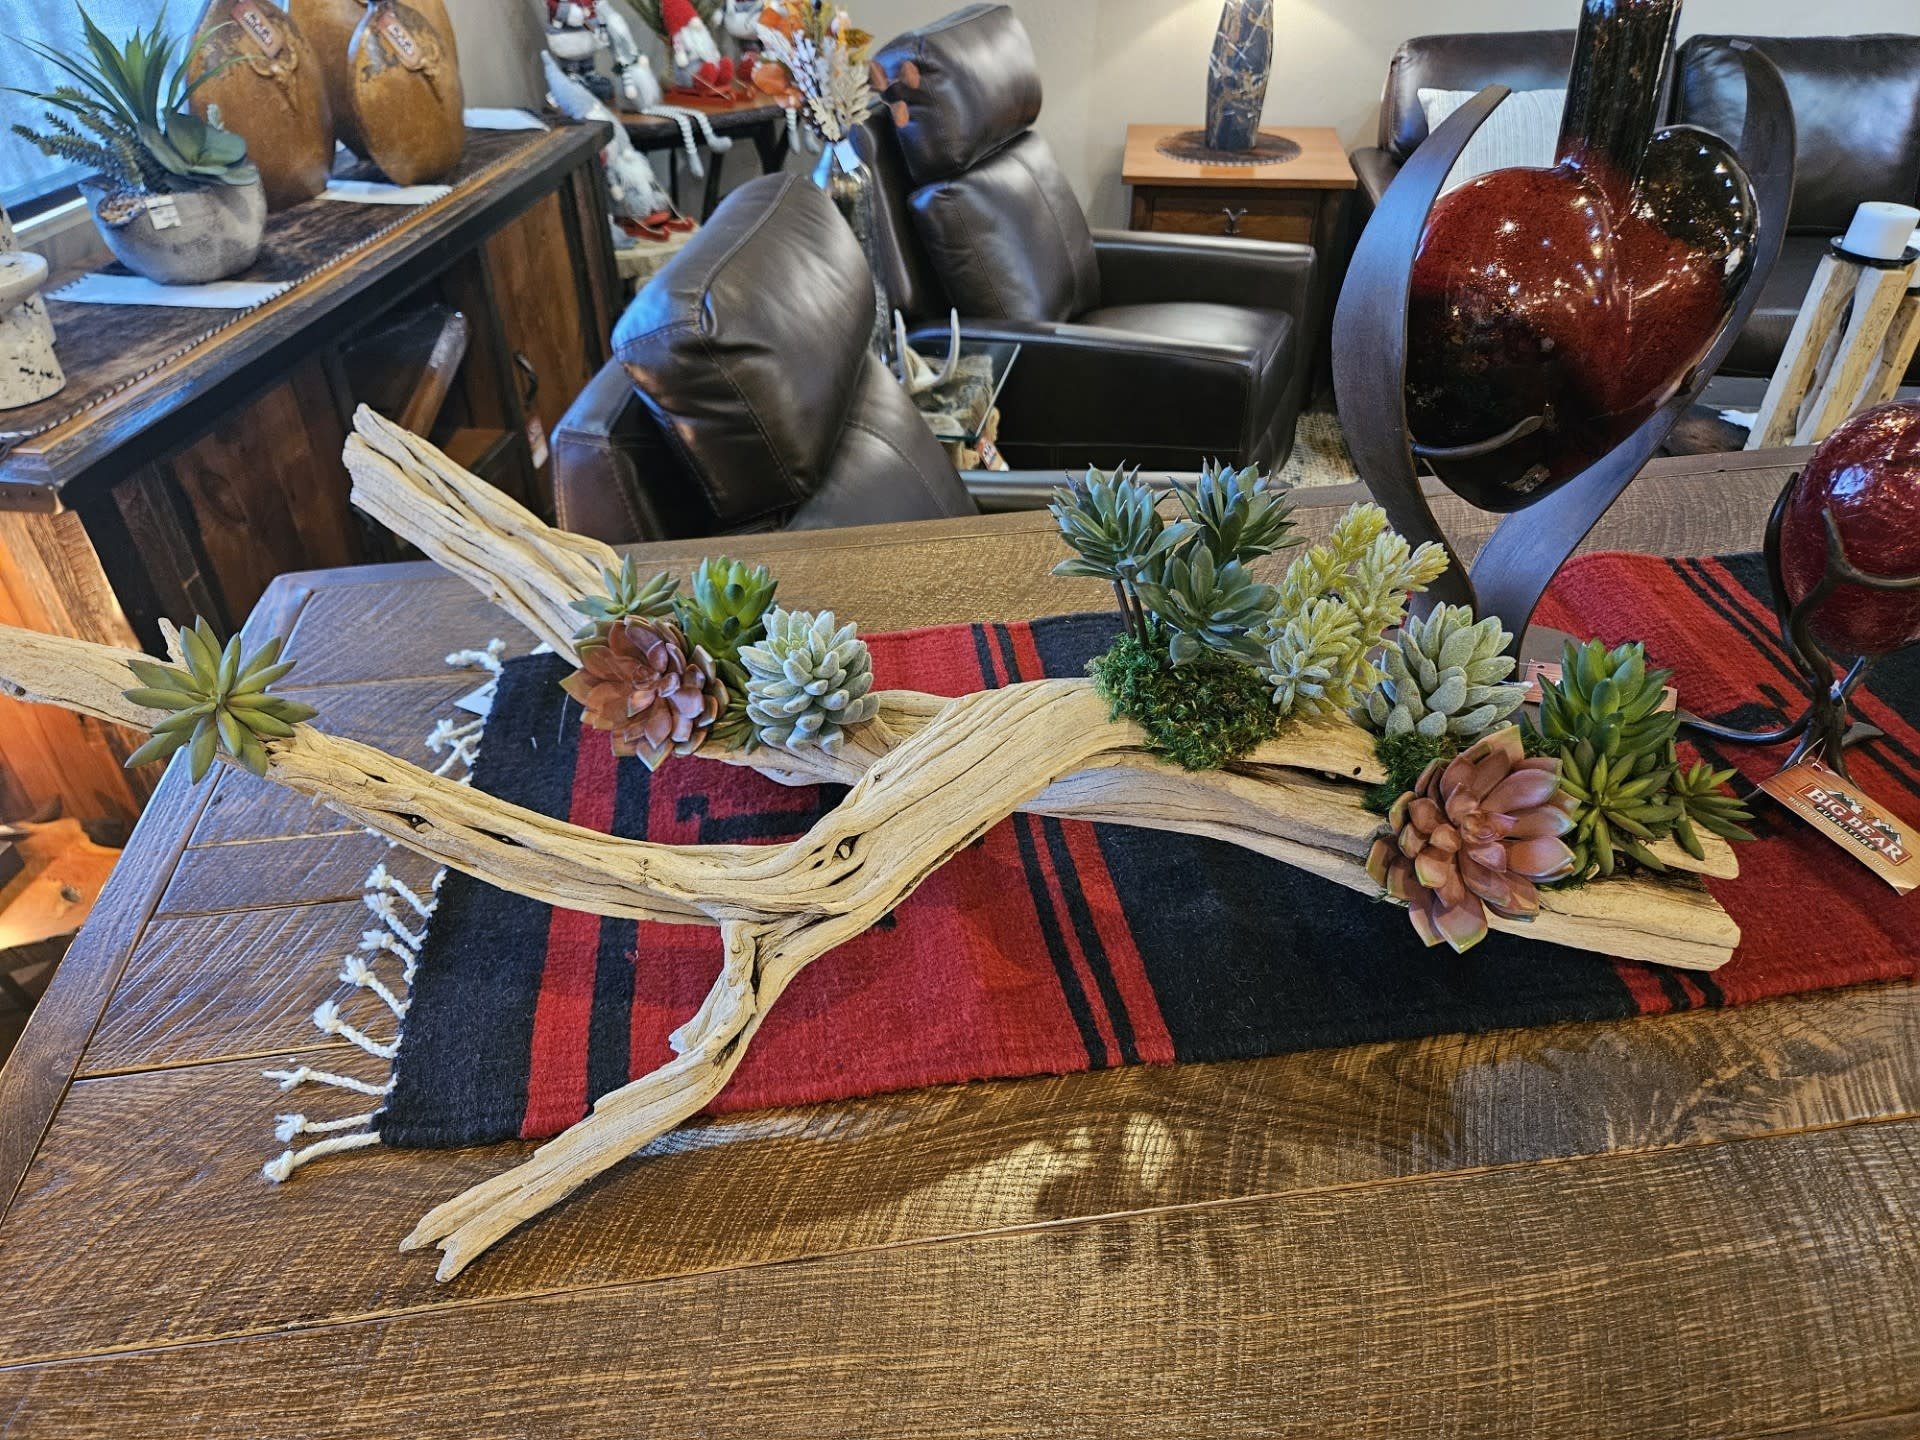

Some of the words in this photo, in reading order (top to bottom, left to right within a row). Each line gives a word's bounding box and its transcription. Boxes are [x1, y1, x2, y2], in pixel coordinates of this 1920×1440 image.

[1804, 787, 1847, 816] BIG
[1846, 816, 1904, 862] BEAR
[1816, 806, 1875, 850] FURNITURE
